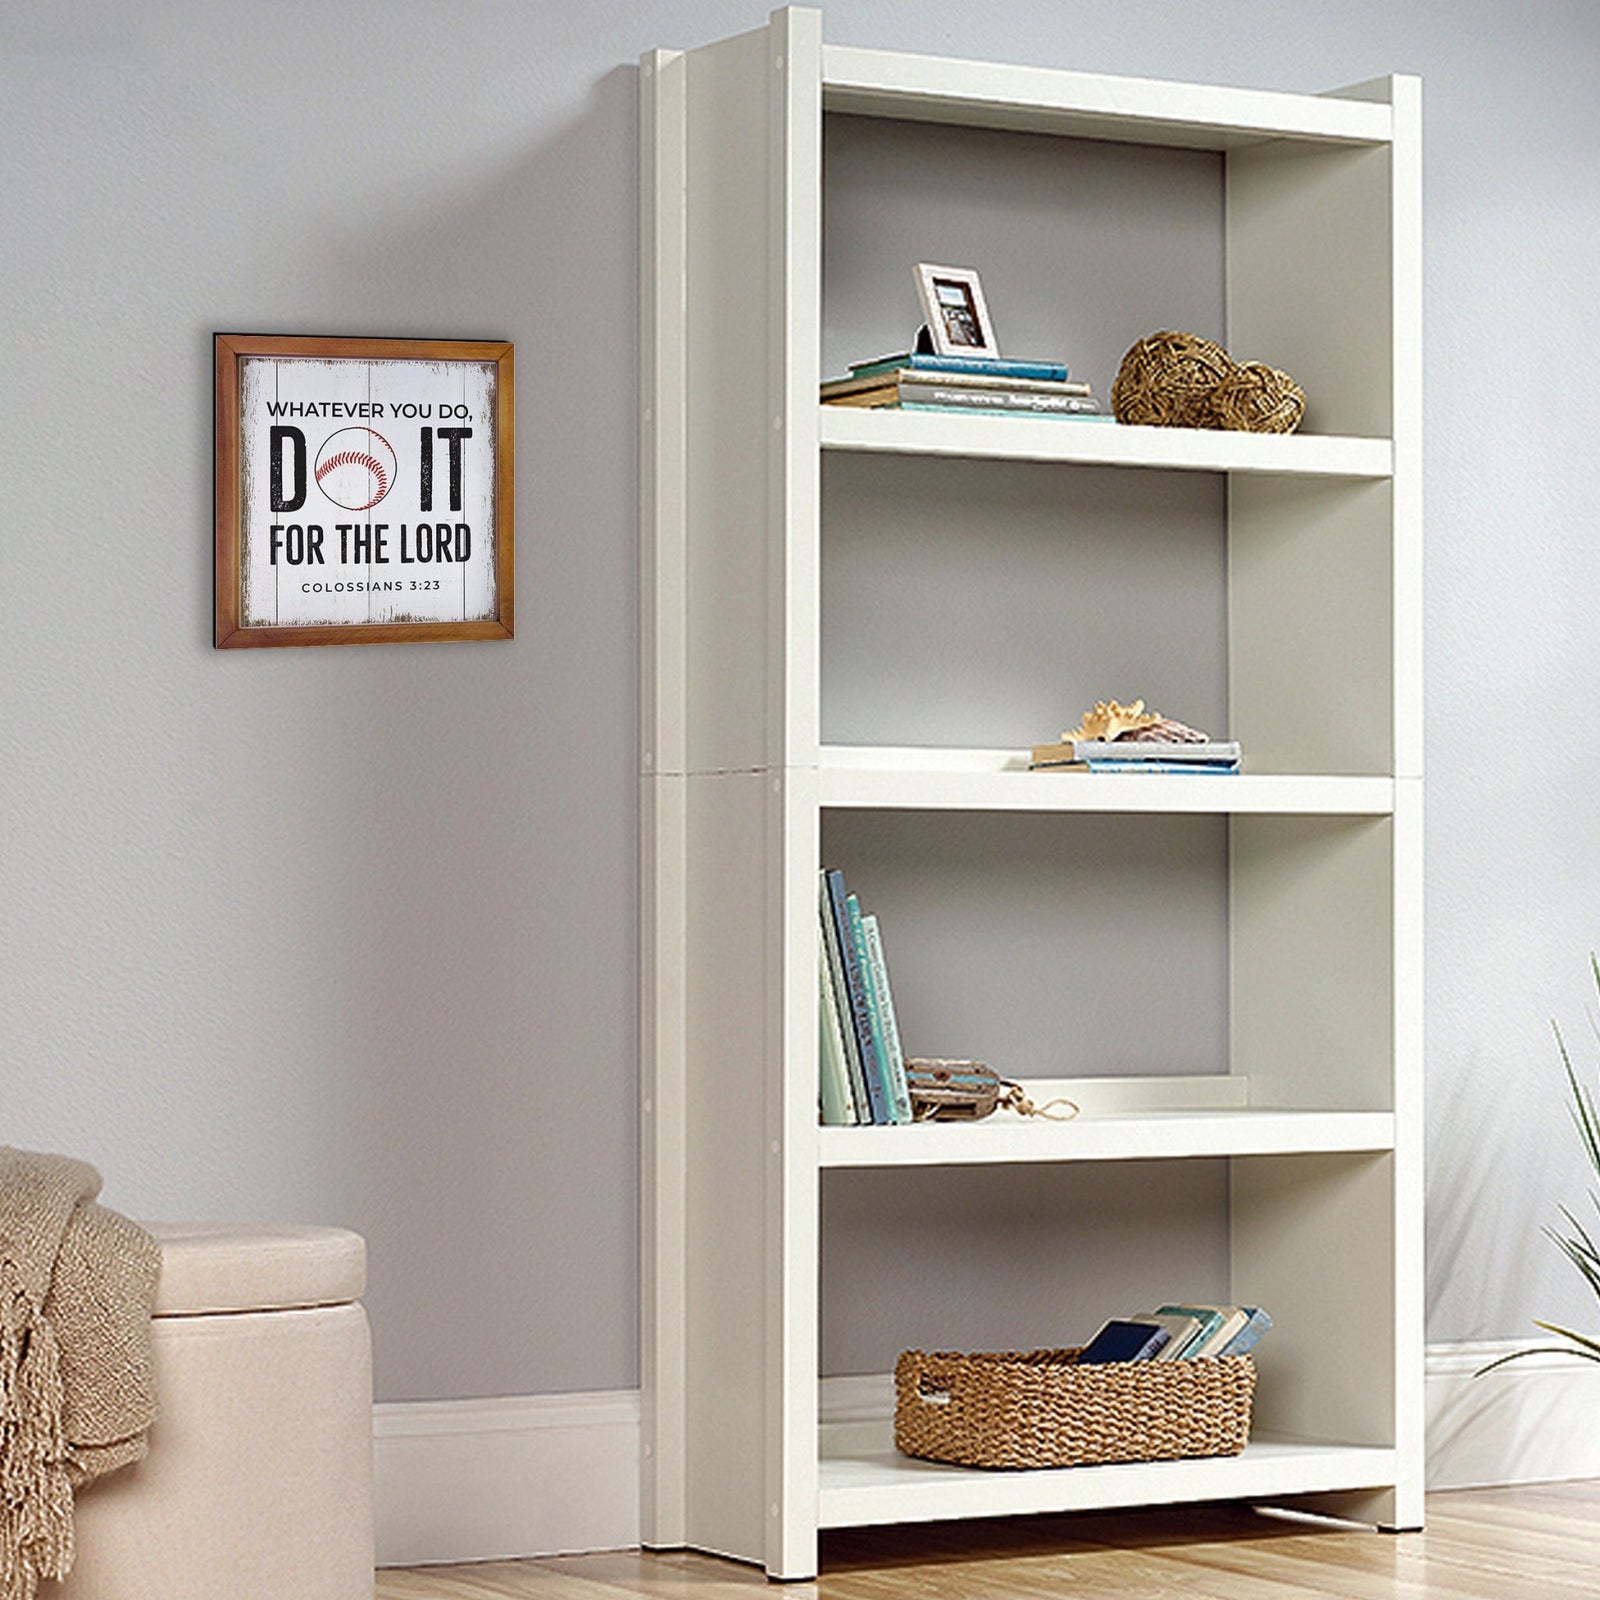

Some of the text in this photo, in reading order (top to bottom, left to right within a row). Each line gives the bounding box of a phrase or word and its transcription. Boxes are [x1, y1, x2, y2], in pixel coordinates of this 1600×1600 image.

[266, 401, 473, 422] WHATEVER YOU DO,
[420, 426, 473, 512] IT
[269, 523, 472, 566] FOR THE LORD
[301, 580, 441, 593] COLOSSIANS 3:23
